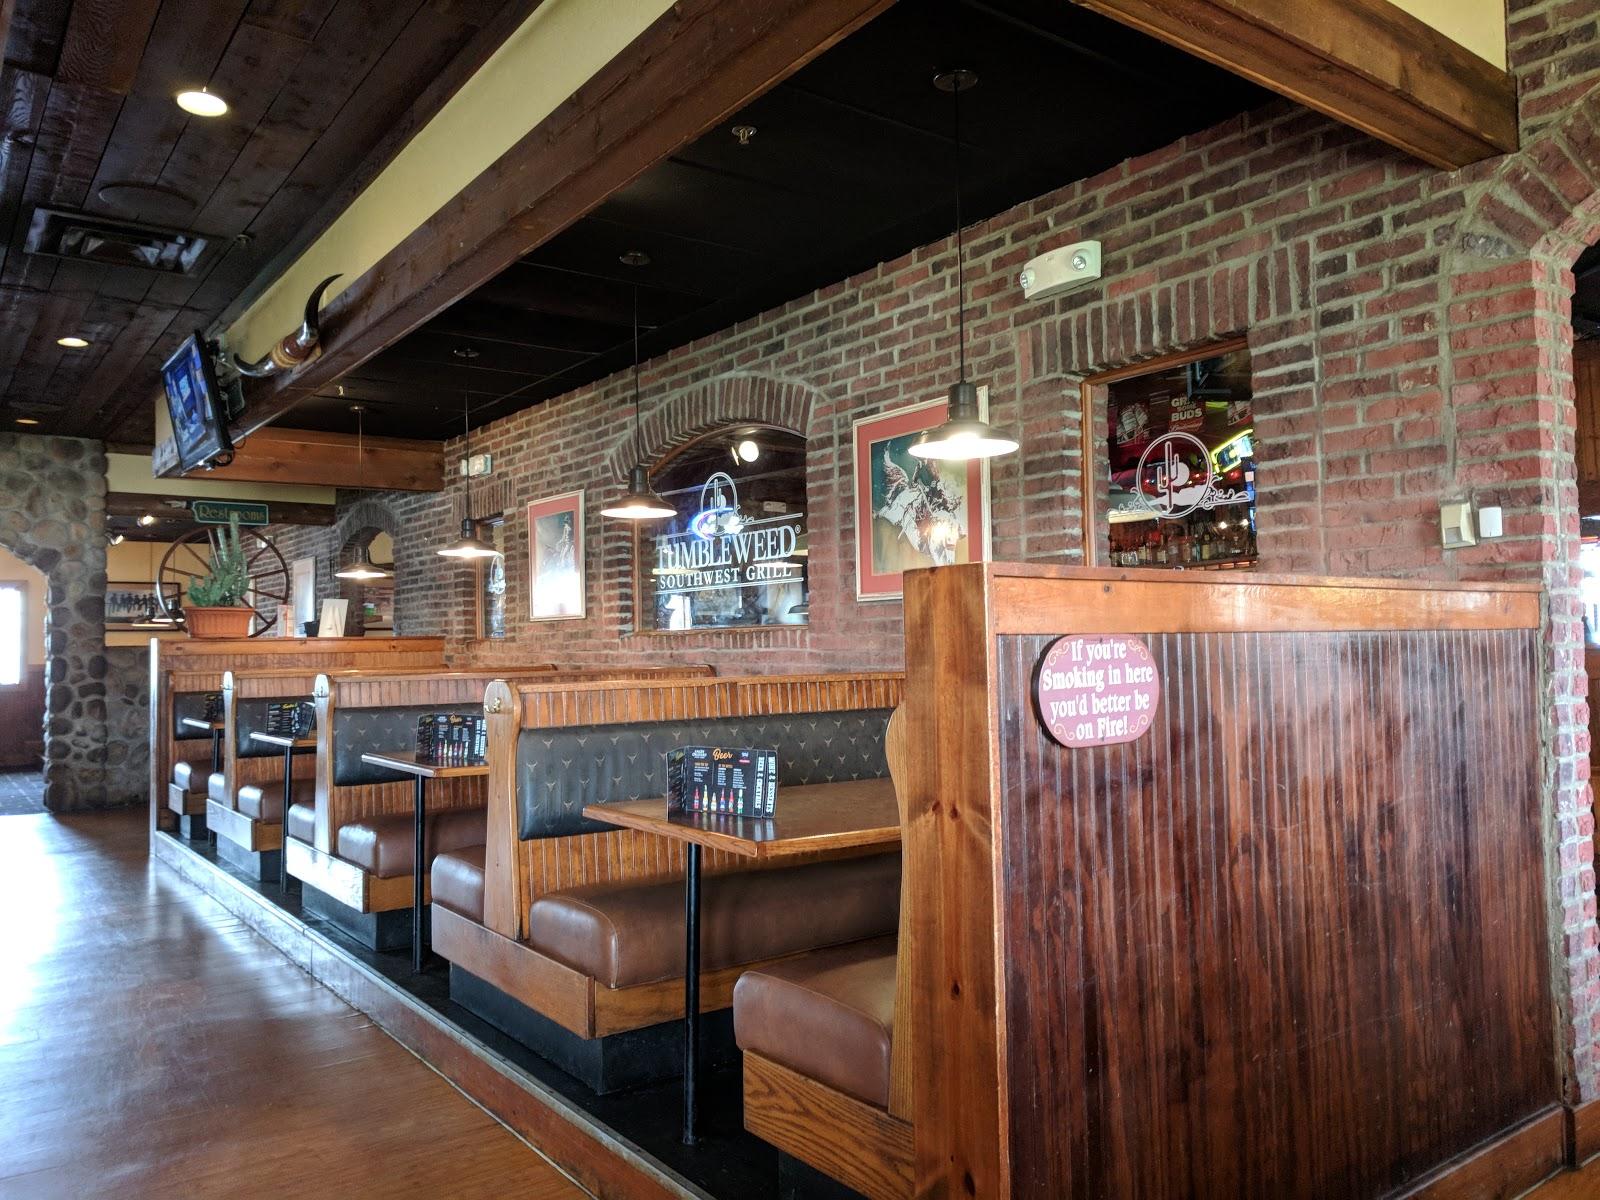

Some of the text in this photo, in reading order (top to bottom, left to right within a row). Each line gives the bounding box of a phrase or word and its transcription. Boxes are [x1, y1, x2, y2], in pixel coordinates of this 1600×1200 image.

[1171, 408, 1203, 422] BUDS
[199, 504, 265, 521] Restoms
[657, 525, 797, 571] TUMBLEWEED
[659, 564, 792, 590] SOUTHWEST GRILL
[1071, 639, 1127, 666] If you're
[1042, 663, 1153, 692] Smoking in here
[1049, 689, 1150, 725] you'd better be
[1076, 715, 1128, 740] on Fire!
[712, 748, 733, 760] Beer
